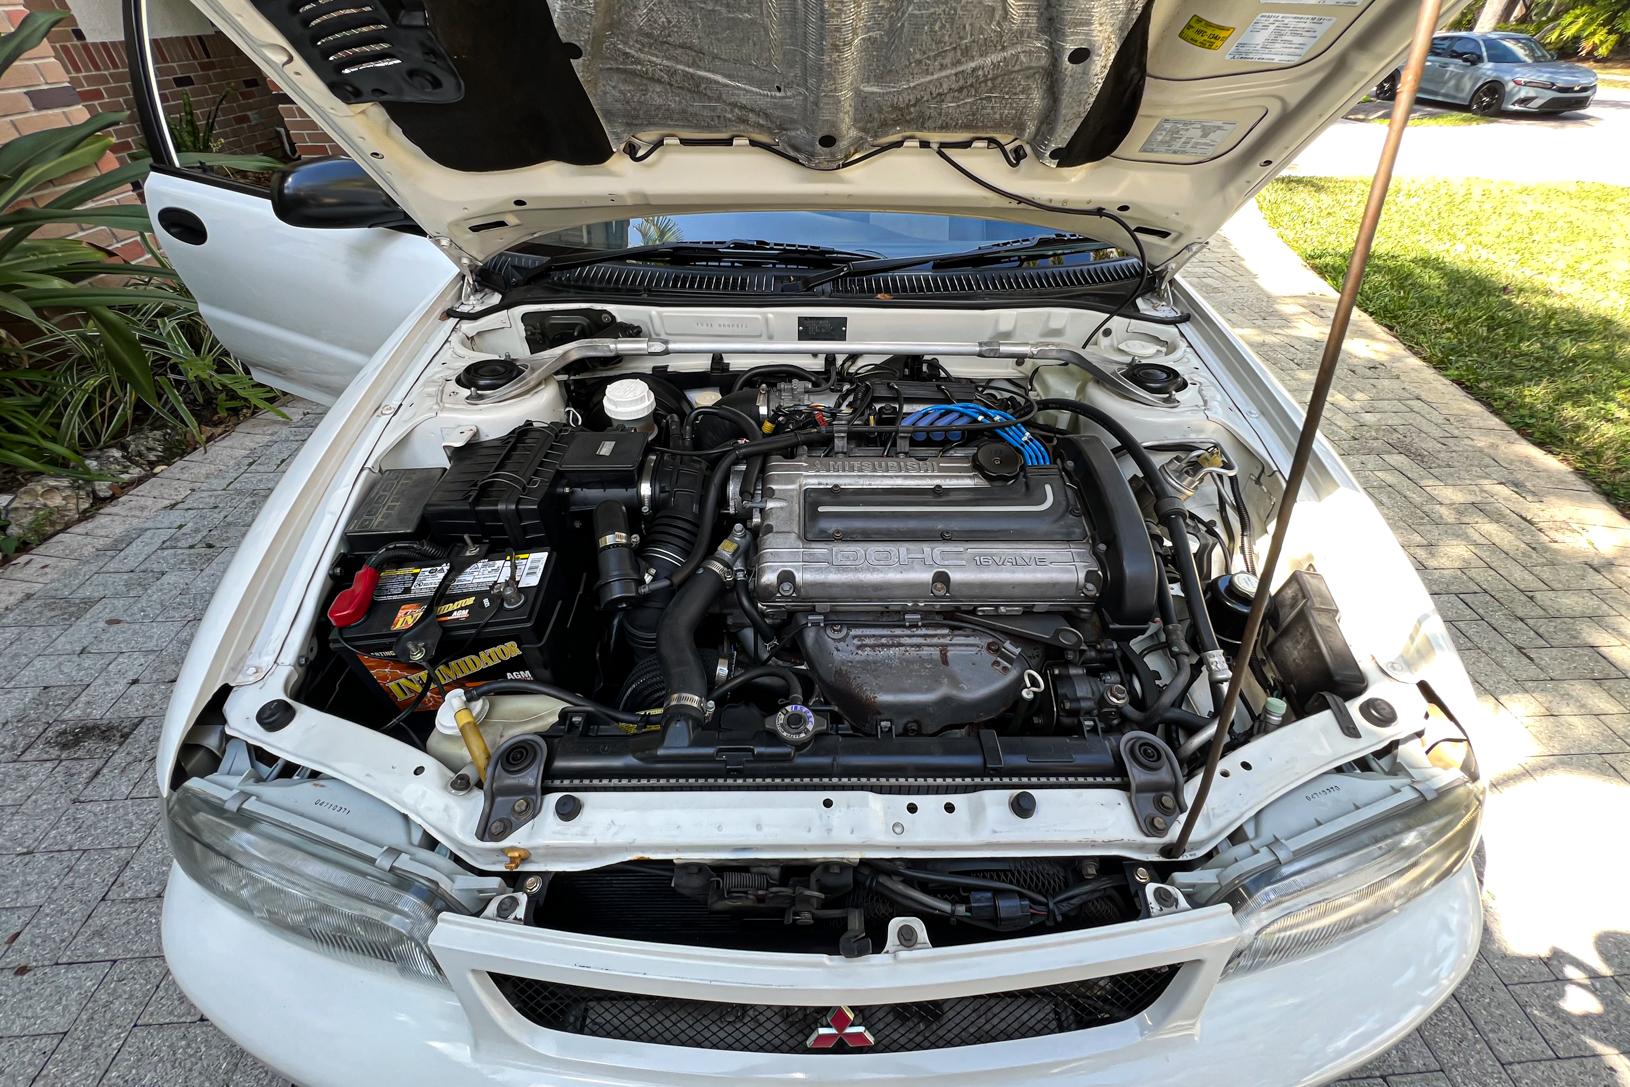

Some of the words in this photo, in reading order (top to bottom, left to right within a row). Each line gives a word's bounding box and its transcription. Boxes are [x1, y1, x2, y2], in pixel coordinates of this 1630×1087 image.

[828, 460, 938, 474] MITSUBISHI
[831, 546, 967, 567] DOHC
[973, 556, 1048, 567] 16VALVE
[506, 670, 531, 680] AGM
